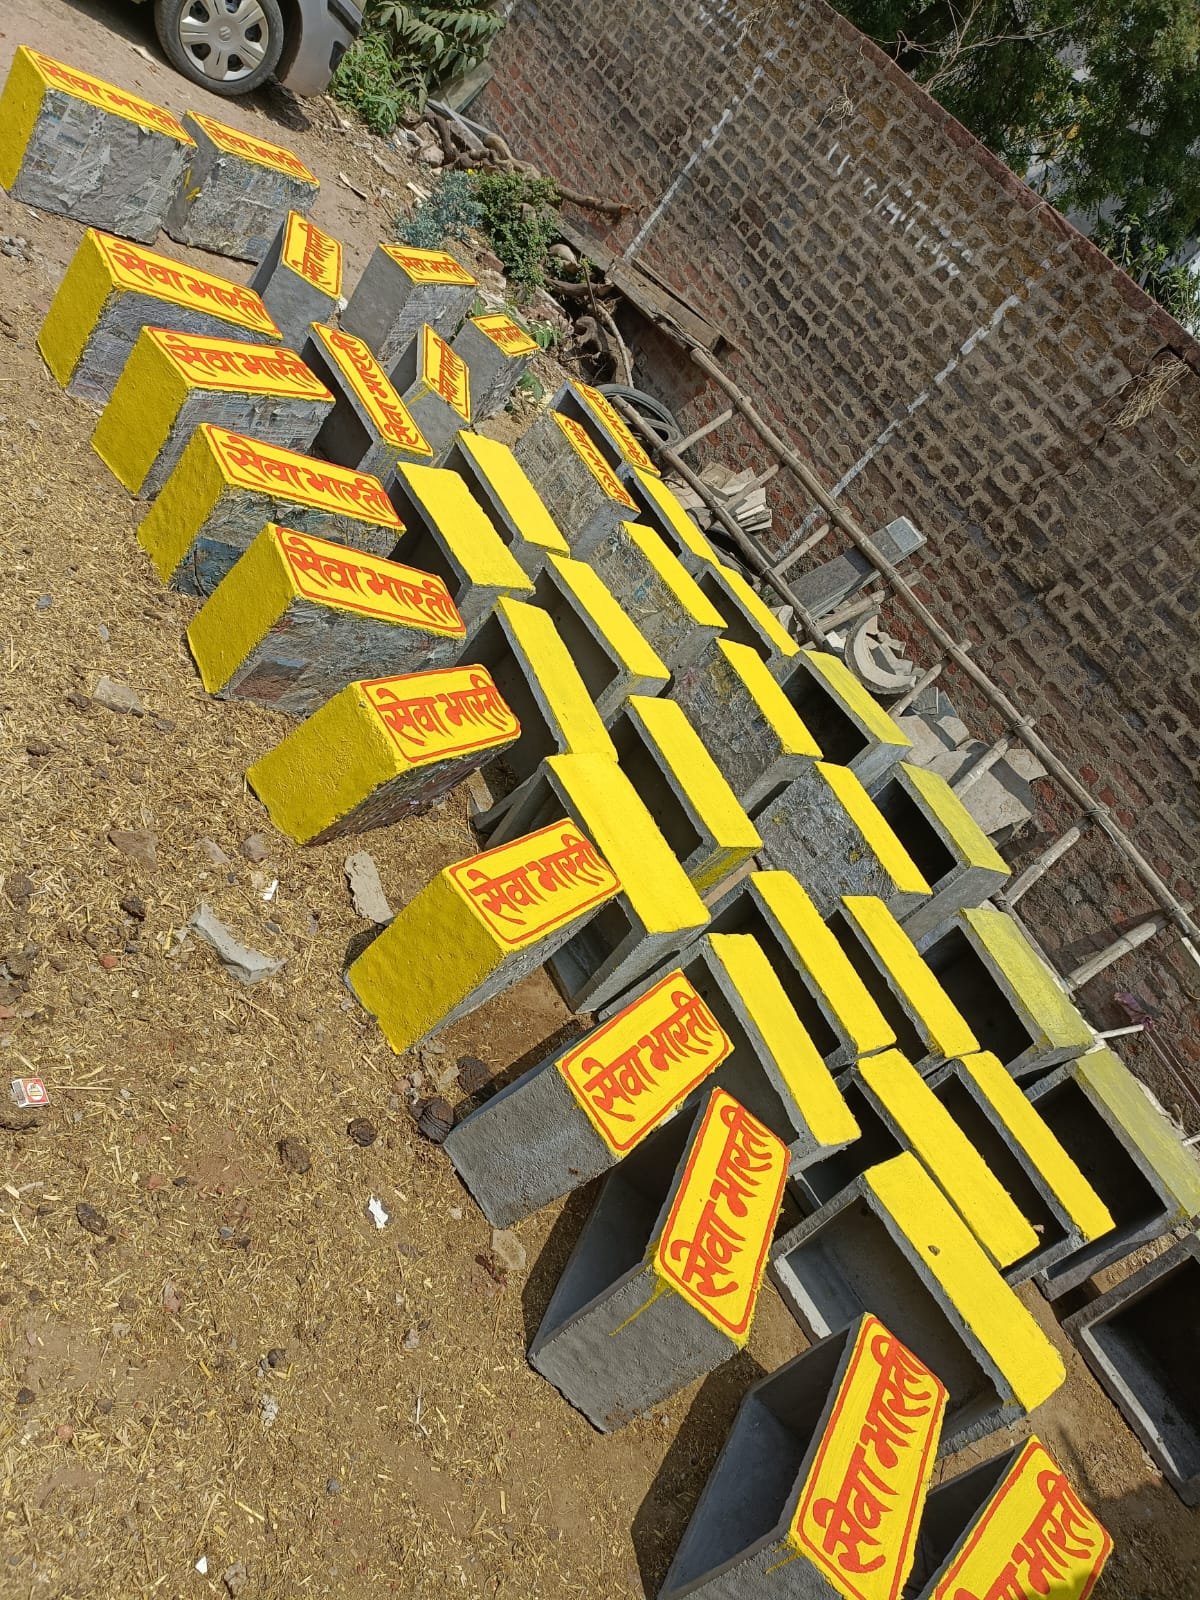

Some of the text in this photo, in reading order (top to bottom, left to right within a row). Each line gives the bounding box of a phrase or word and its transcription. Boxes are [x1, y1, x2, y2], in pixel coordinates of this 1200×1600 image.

[38, 55, 107, 102] सेवा
[108, 243, 270, 327] सेवा भारती
[165, 335, 325, 390] सेवा भारती
[330, 330, 419, 445] सेवा भारती
[220, 436, 396, 520] सेवा भारती
[285, 537, 460, 627] सेवा भारती
[376, 674, 513, 746] सेवा भारती
[468, 833, 608, 925] सेवा भारती
[582, 991, 717, 1122] सेवा भारती
[671, 1105, 772, 1297] सेवा भारती
[813, 1335, 931, 1573] सेवा भारती
[1011, 1470, 1096, 1595] भारती
